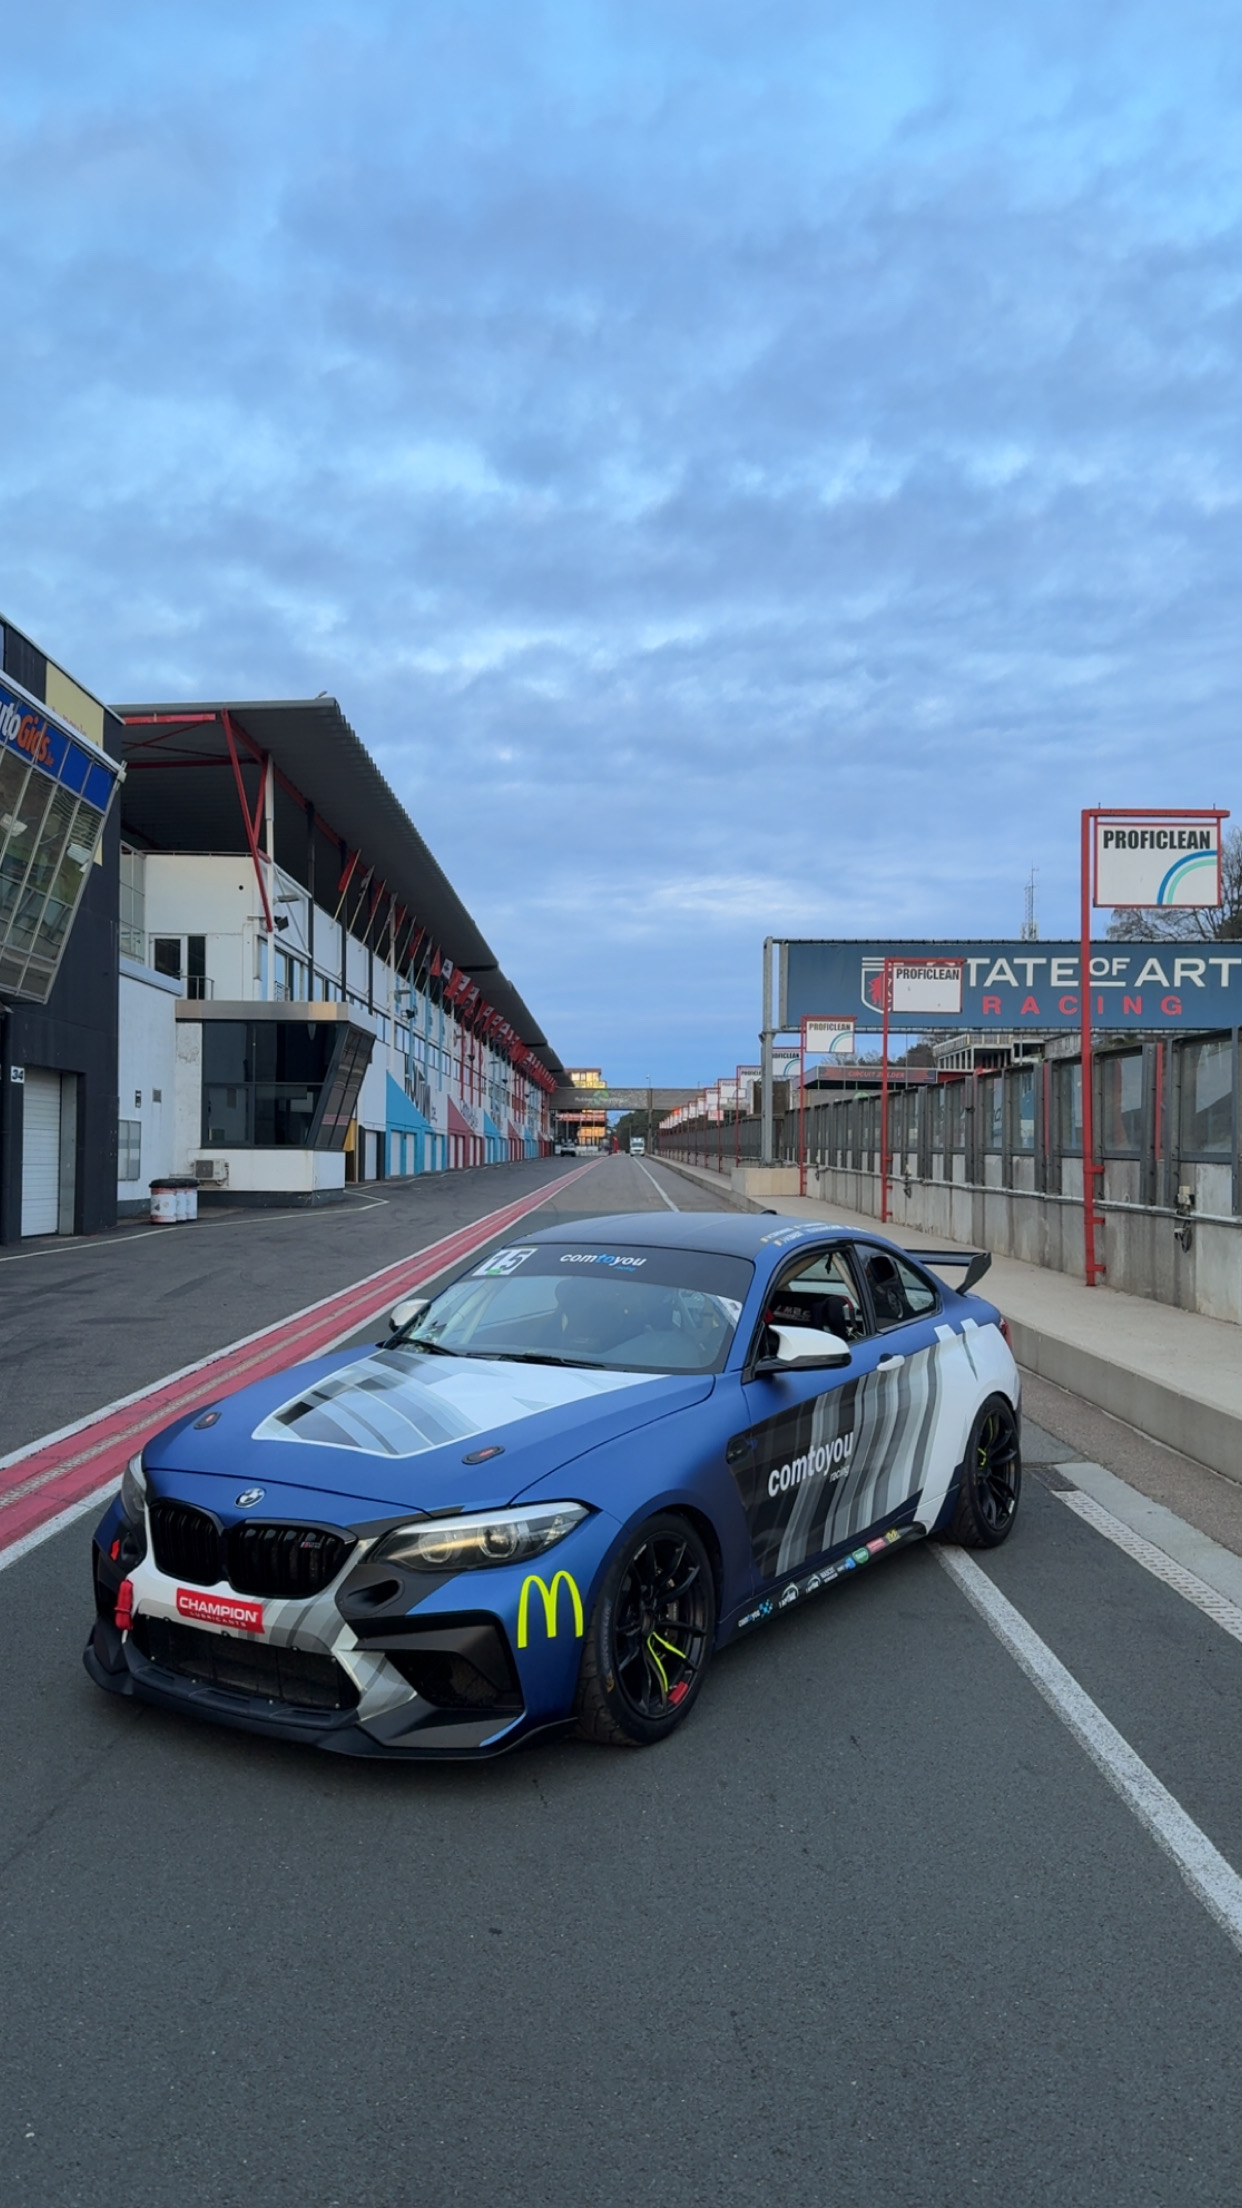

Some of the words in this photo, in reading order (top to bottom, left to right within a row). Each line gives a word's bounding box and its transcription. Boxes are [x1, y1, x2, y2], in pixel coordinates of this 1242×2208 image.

[1103, 830, 1211, 850] PROFICLEAN
[896, 968, 960, 980] PROFICLEAN
[926, 957, 1079, 987] TATE
[1089, 957, 1131, 976] OF
[1133, 958, 1242, 987] ART
[982, 995, 1183, 1015] RACING
[808, 1022, 852, 1032] PROFICLEAN
[12, 1069, 24, 1081] 34
[876, 1071, 905, 1079] ZLDER
[560, 1253, 648, 1267] comtoyou
[768, 1432, 854, 1498] comtoyou
[179, 1596, 257, 1623] CHAMPION
[189, 1611, 247, 1627] LUBRICANTS
